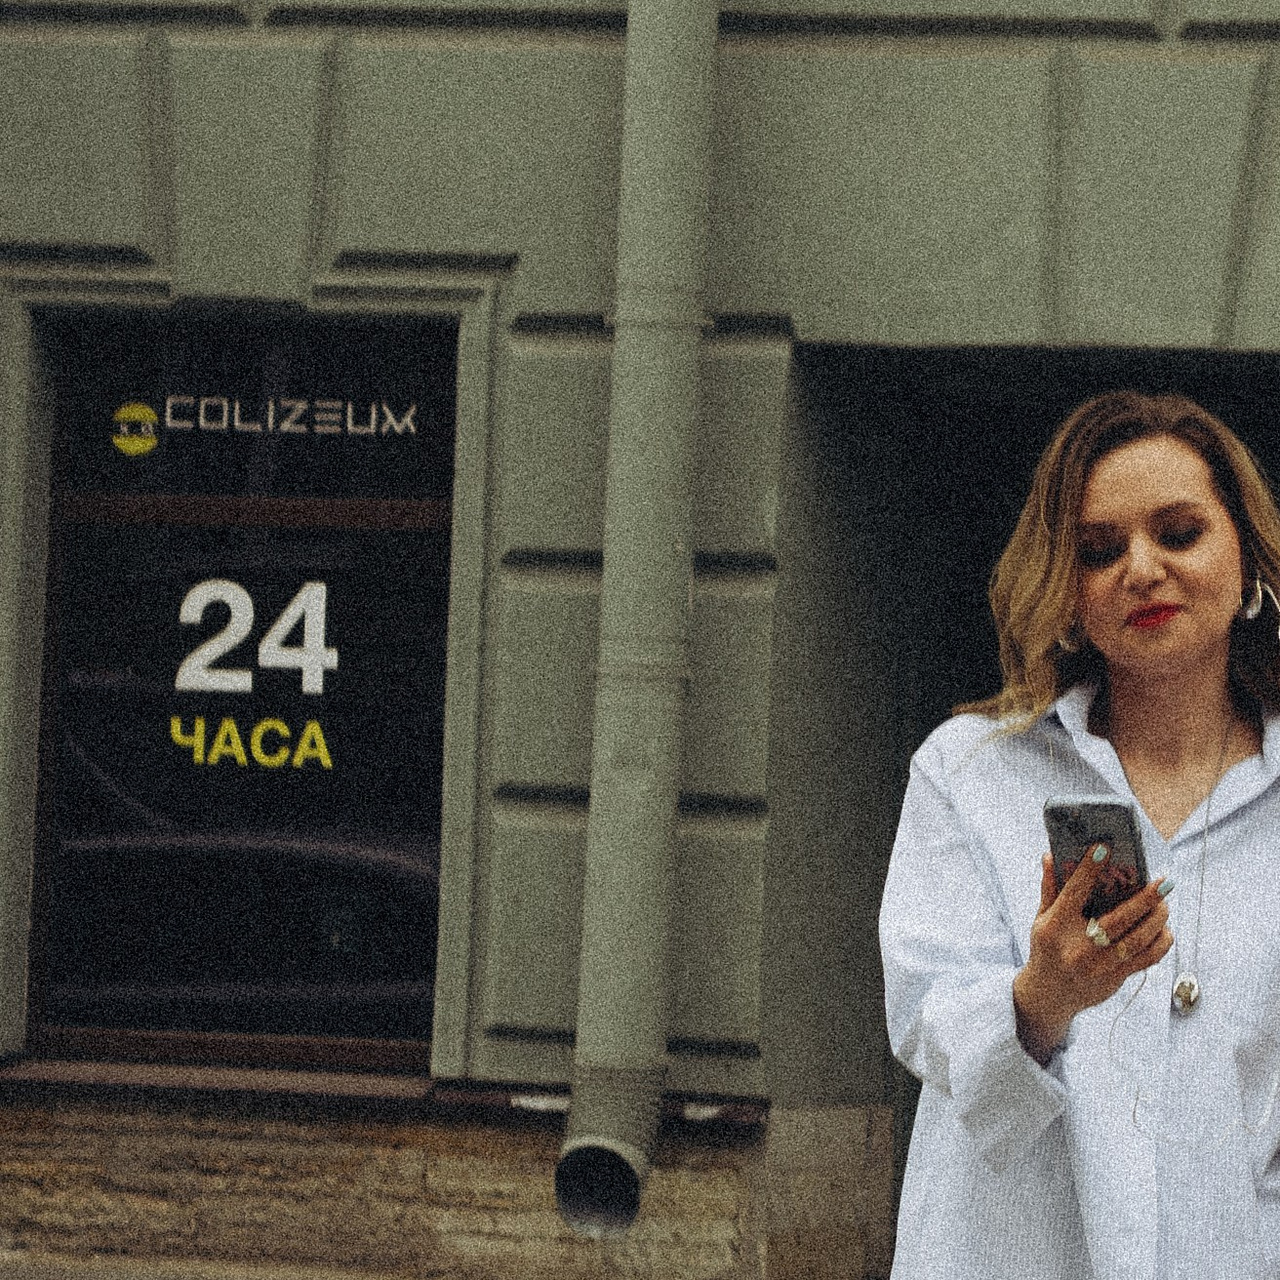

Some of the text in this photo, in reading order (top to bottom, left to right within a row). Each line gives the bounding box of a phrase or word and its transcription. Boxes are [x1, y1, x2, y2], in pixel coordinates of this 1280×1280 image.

[165, 394, 416, 435] COLIZEUM
[175, 578, 338, 695] 24
[170, 716, 333, 769] ЧАСА
